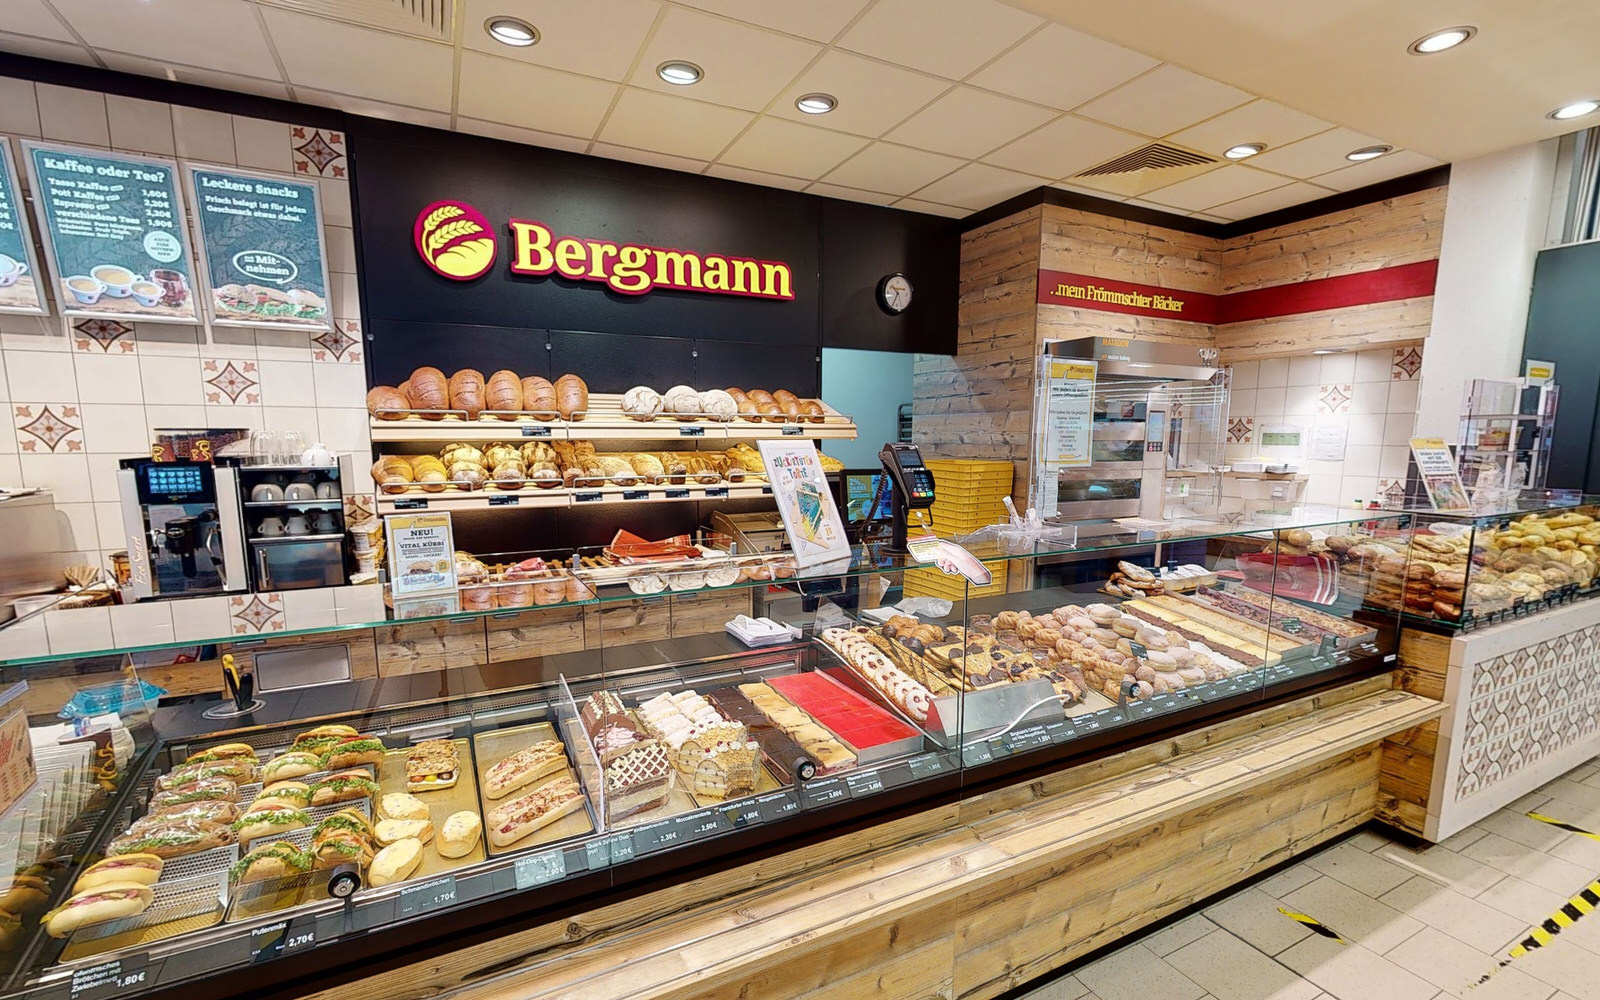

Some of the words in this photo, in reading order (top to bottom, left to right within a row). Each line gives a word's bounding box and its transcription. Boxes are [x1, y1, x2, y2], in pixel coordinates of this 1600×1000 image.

[43, 158, 94, 174] Kaffee
[97, 166, 130, 178] oder
[132, 170, 165, 183] Tee?
[47, 177, 76, 188] Tasse
[76, 181, 109, 192] Kaffee
[201, 177, 253, 193] Leckere
[255, 184, 299, 199] Snacks
[50, 188, 72, 198] Pott
[73, 191, 105, 201] Kaffee
[53, 198, 95, 210] Espresso
[205, 195, 232, 205] Frisch
[232, 198, 258, 209] belegt
[271, 203, 283, 211] für
[285, 205, 307, 214] jeden
[55, 209, 117, 222] verschiedene
[206, 205, 252, 216] Geschmack
[253, 211, 277, 219] etwas
[278, 213, 302, 222] dabei.
[255, 255, 281, 265] Mit-
[510, 219, 794, 299] Bergmann
[245, 264, 290, 276] nehmen
[1152, 295, 1184, 312] Bäcker
[787, 467, 809, 480] TORTE
[410, 528, 434, 537] NEU!
[401, 878, 450, 895] Schmandbrötchen
[434, 891, 455, 903] 1,70€
[251, 922, 287, 936] Putenmäx
[288, 933, 314, 947] 2,70€
[72, 971, 108, 985] Brötchen
[116, 971, 146, 988] 1,80€
